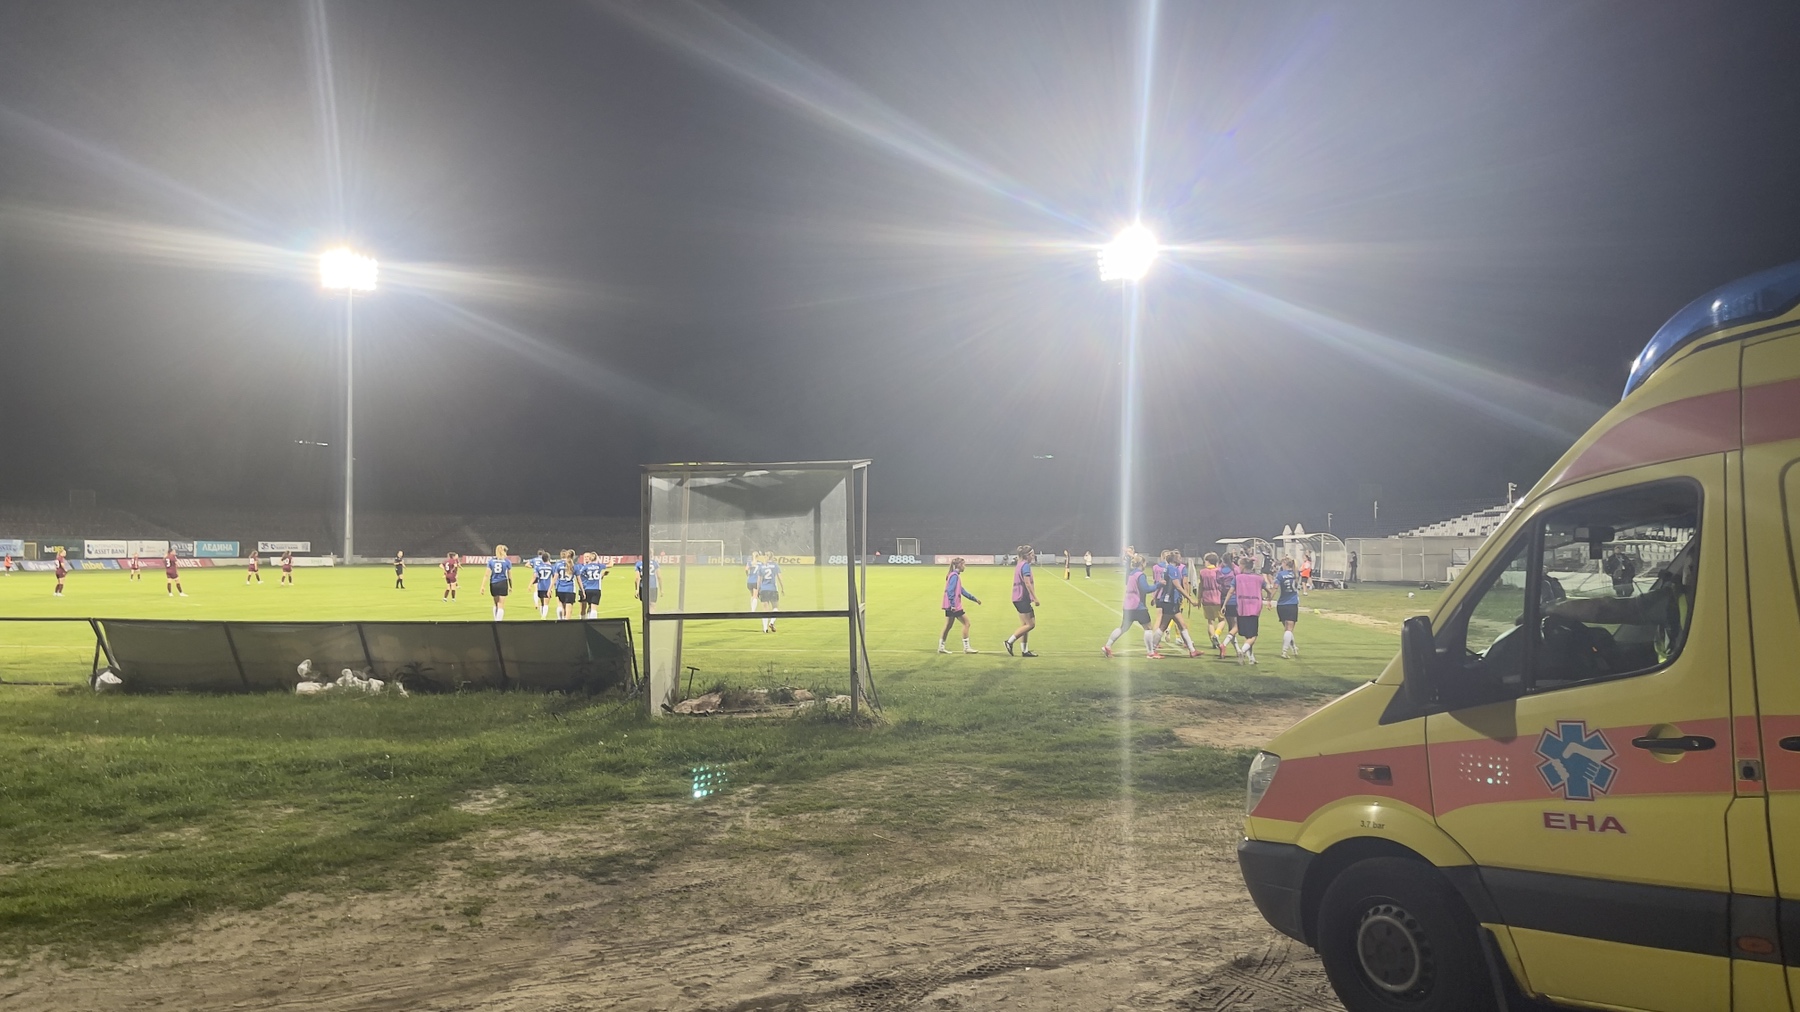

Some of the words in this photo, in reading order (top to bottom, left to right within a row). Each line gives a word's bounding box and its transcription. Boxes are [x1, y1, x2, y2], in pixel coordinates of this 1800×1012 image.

[202, 543, 233, 551] ЛЕДИНА
[165, 558, 171, 567] 3
[465, 556, 493, 564] WINB
[493, 562, 503, 574] 8
[539, 569, 552, 580] 17
[587, 570, 600, 580] 16
[764, 568, 773, 580] 2
[1372, 820, 1385, 829] bar
